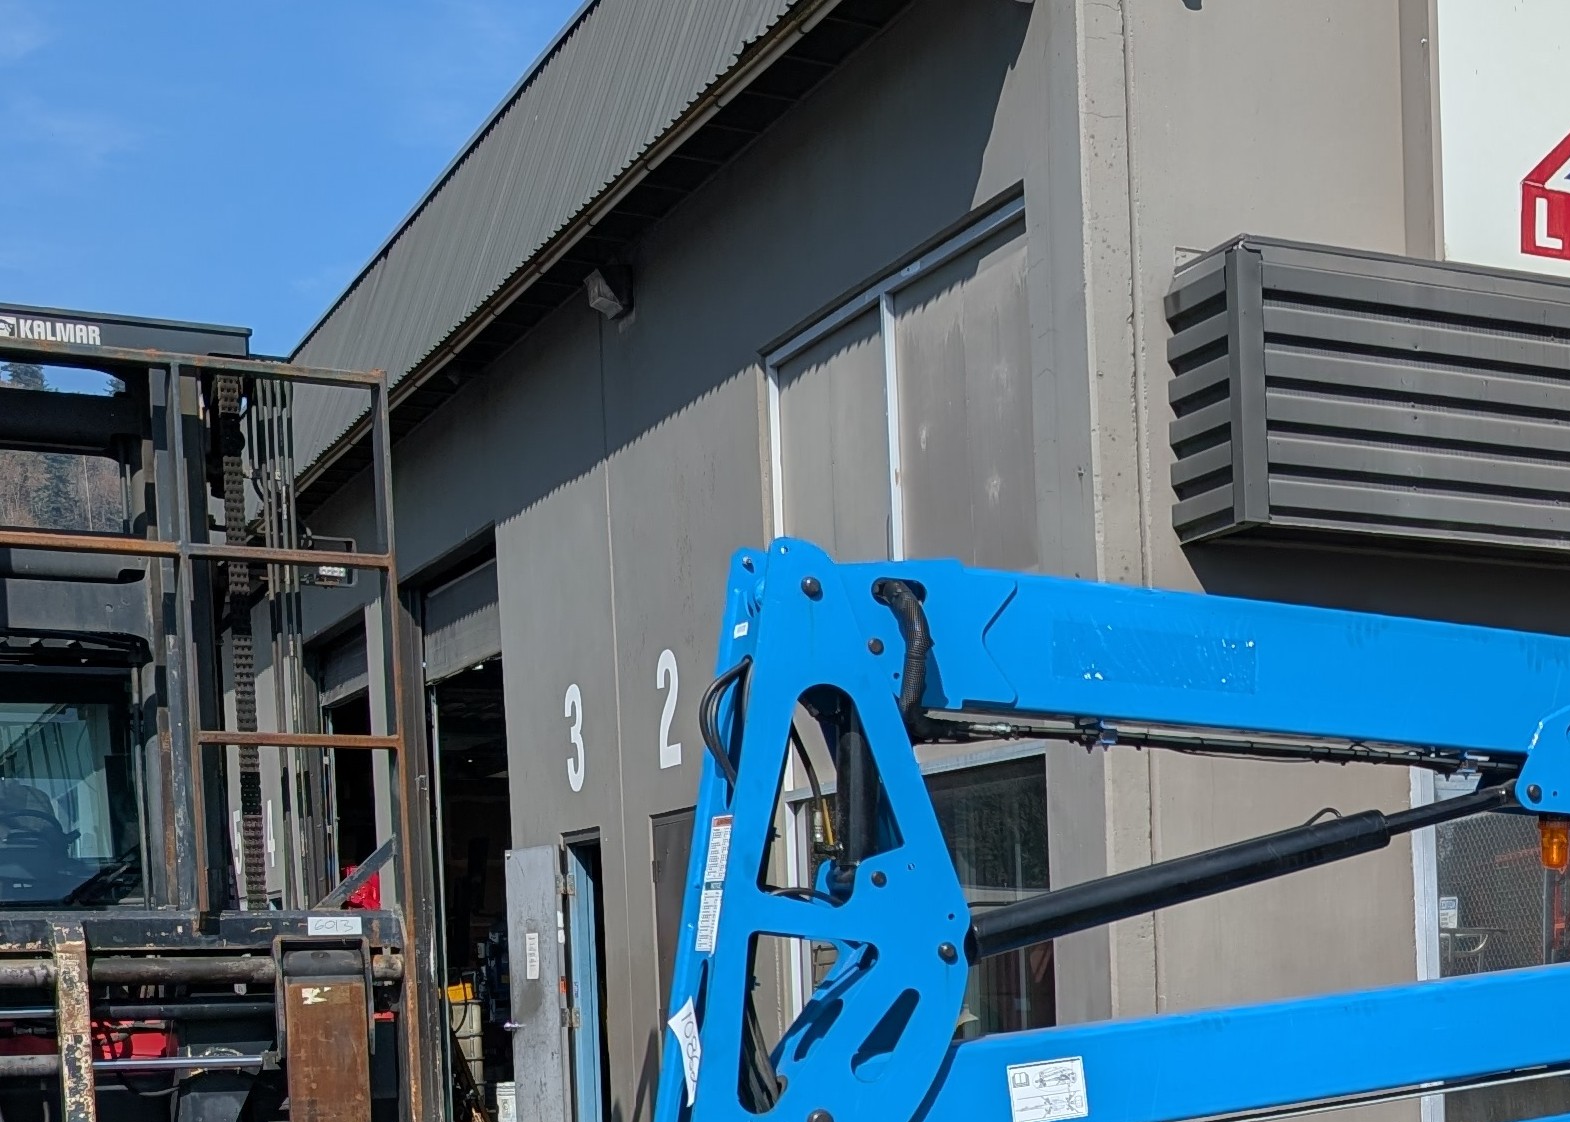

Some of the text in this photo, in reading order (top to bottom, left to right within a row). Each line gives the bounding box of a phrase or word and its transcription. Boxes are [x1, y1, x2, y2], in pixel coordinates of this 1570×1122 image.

[19, 318, 101, 345] KALMAR
[564, 683, 585, 792] 3
[656, 648, 682, 769] 2
[267, 799, 276, 868] 4
[314, 919, 353, 933] 6013
